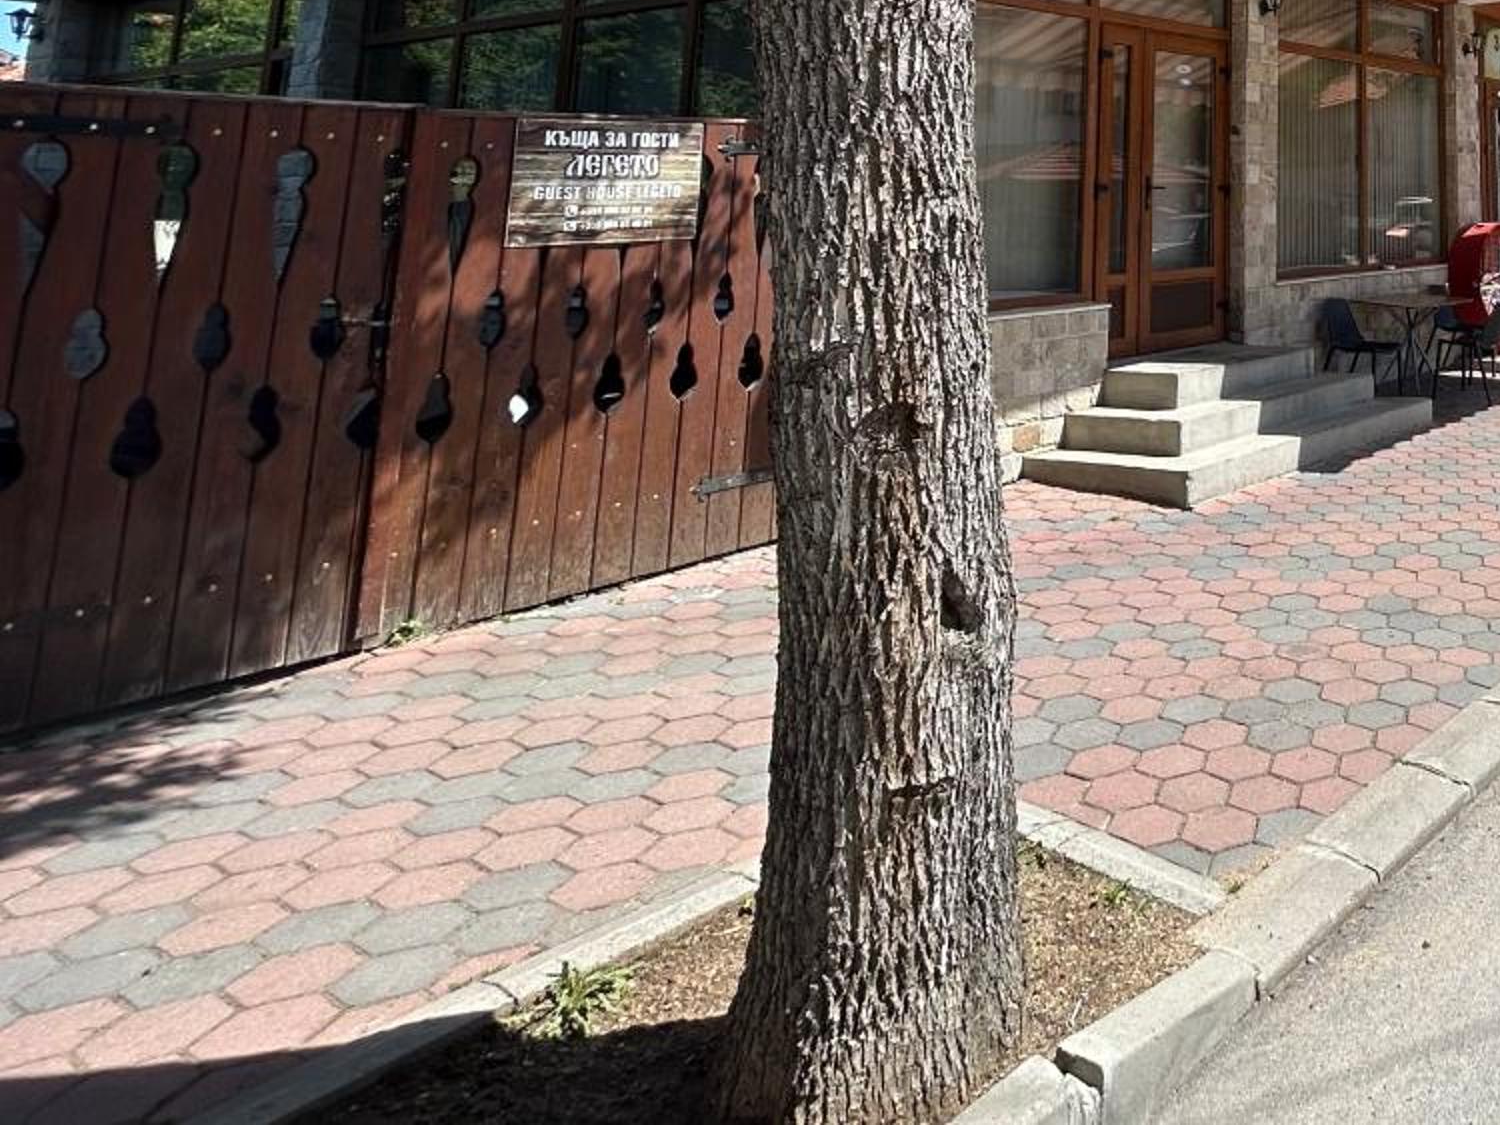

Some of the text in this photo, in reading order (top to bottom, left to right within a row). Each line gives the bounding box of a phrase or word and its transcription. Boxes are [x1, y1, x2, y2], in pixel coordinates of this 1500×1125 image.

[545, 130, 680, 149] КЪЩА ЗА ГОСТИ
[565, 154, 660, 177] ЛЕГЕТО
[534, 184, 682, 200] GUEST HOUSE LEGETO
